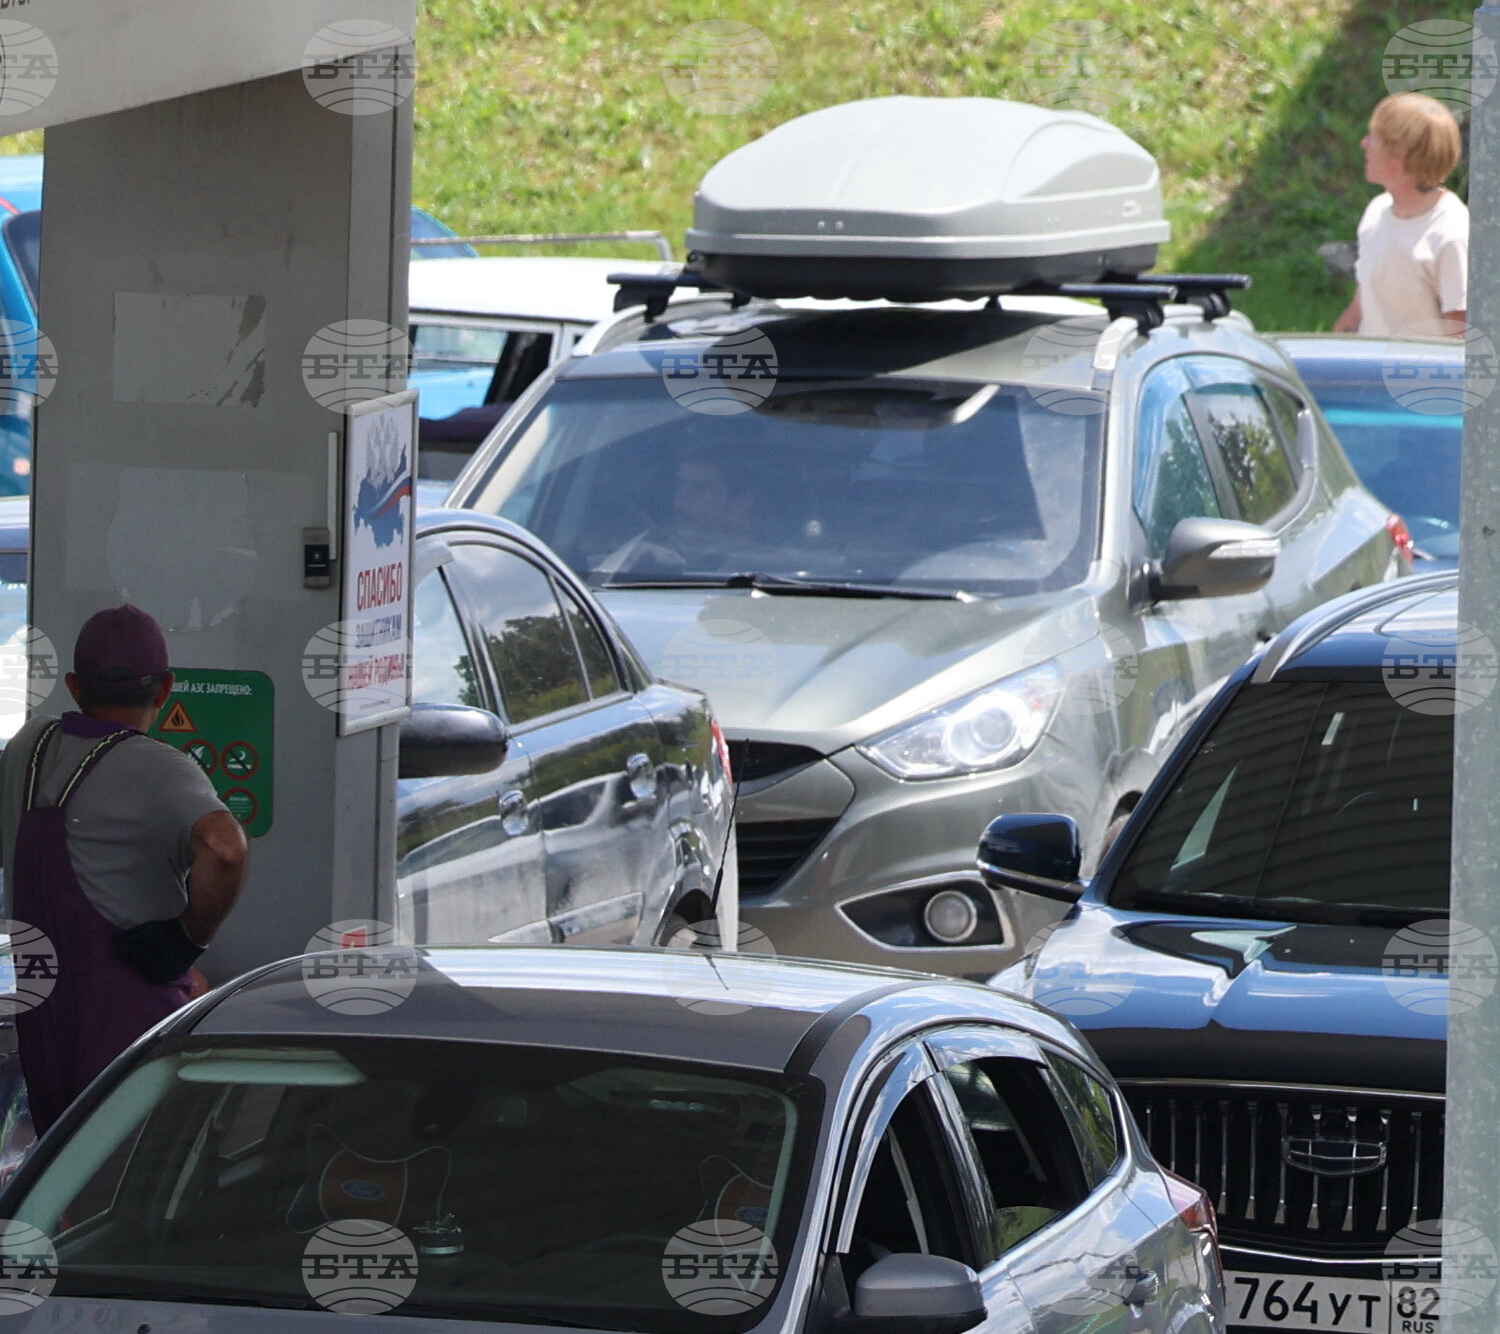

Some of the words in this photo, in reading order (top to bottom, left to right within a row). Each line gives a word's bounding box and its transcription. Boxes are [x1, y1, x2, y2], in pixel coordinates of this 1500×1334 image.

[357, 561, 402, 611] СПАСИБО
[191, 682, 204, 694] АЗС
[1234, 1277, 1381, 1329] 764УТ
[1396, 1286, 1439, 1321] 82
[1402, 1320, 1434, 1334] RUS
